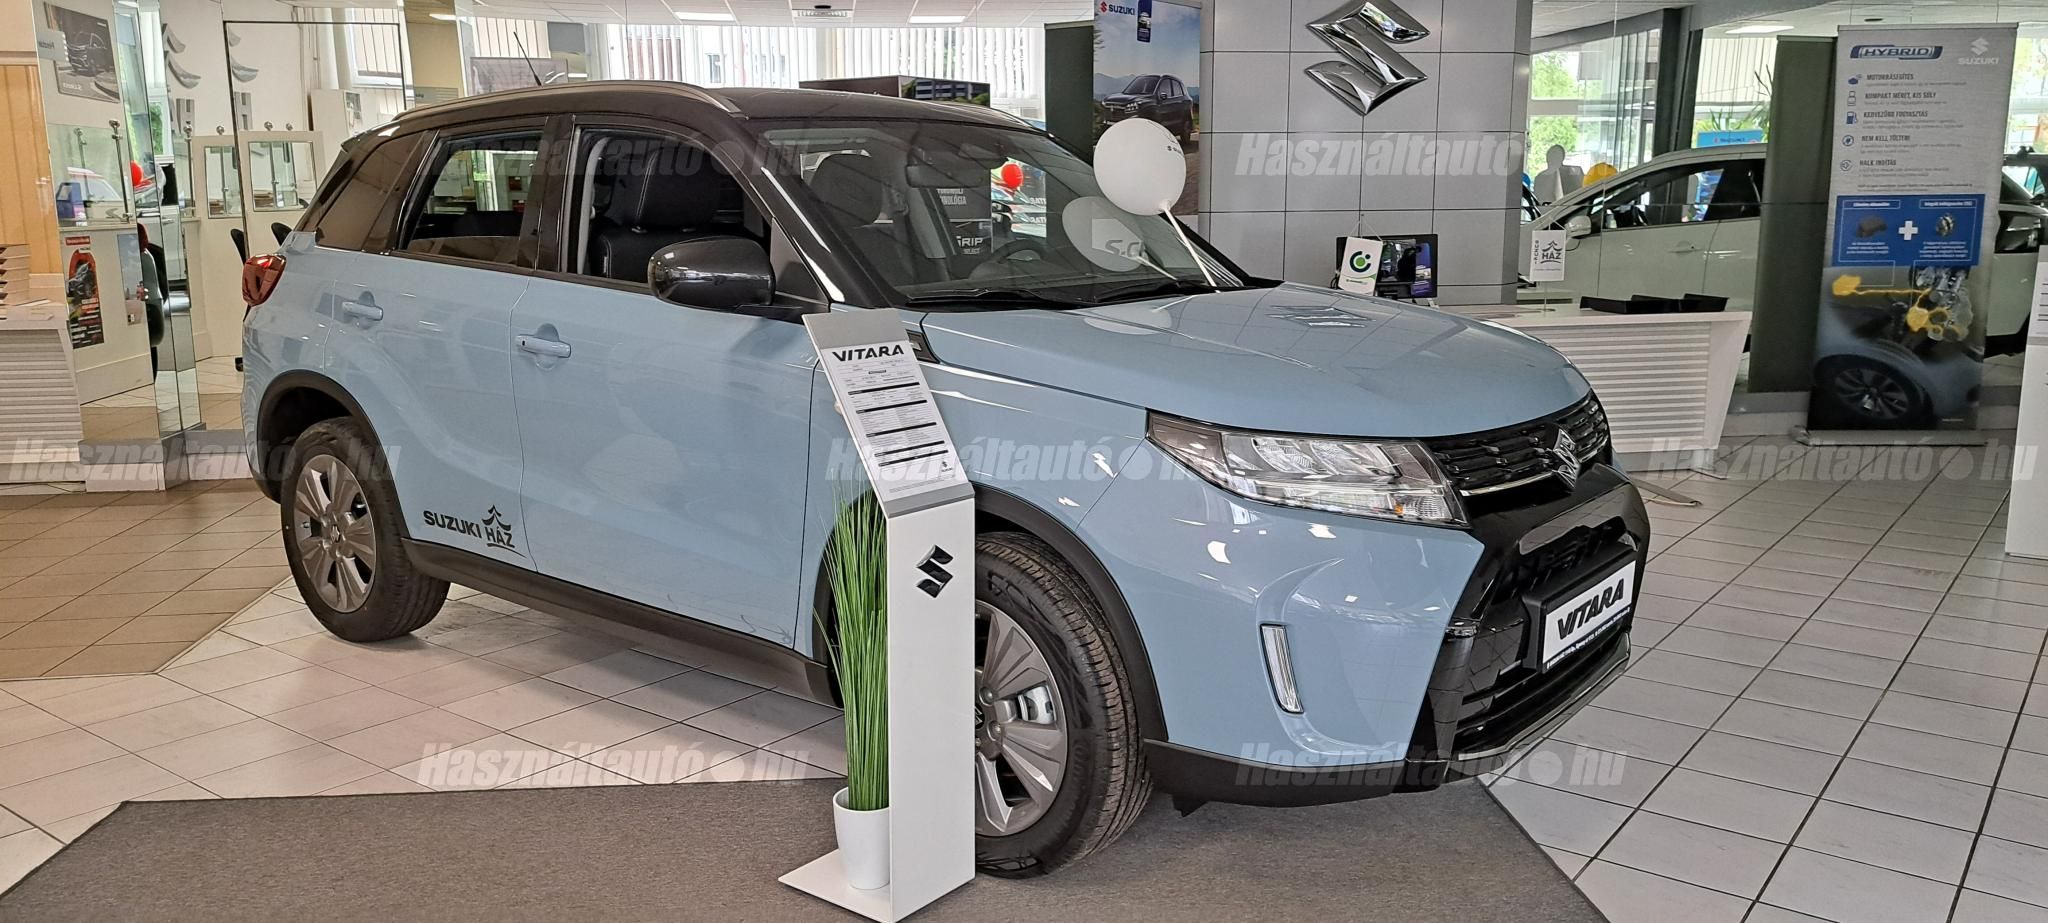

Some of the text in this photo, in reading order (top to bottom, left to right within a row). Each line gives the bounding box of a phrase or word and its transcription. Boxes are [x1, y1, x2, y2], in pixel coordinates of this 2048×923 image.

[1108, 4, 1136, 16] SUZUKI
[1864, 46, 1930, 57] HYBRID
[1958, 57, 2000, 65] SUZUKI
[832, 344, 905, 362] VITARA
[423, 510, 515, 548] SUZUKI HÁZ
[1558, 578, 1625, 640] VITARA
